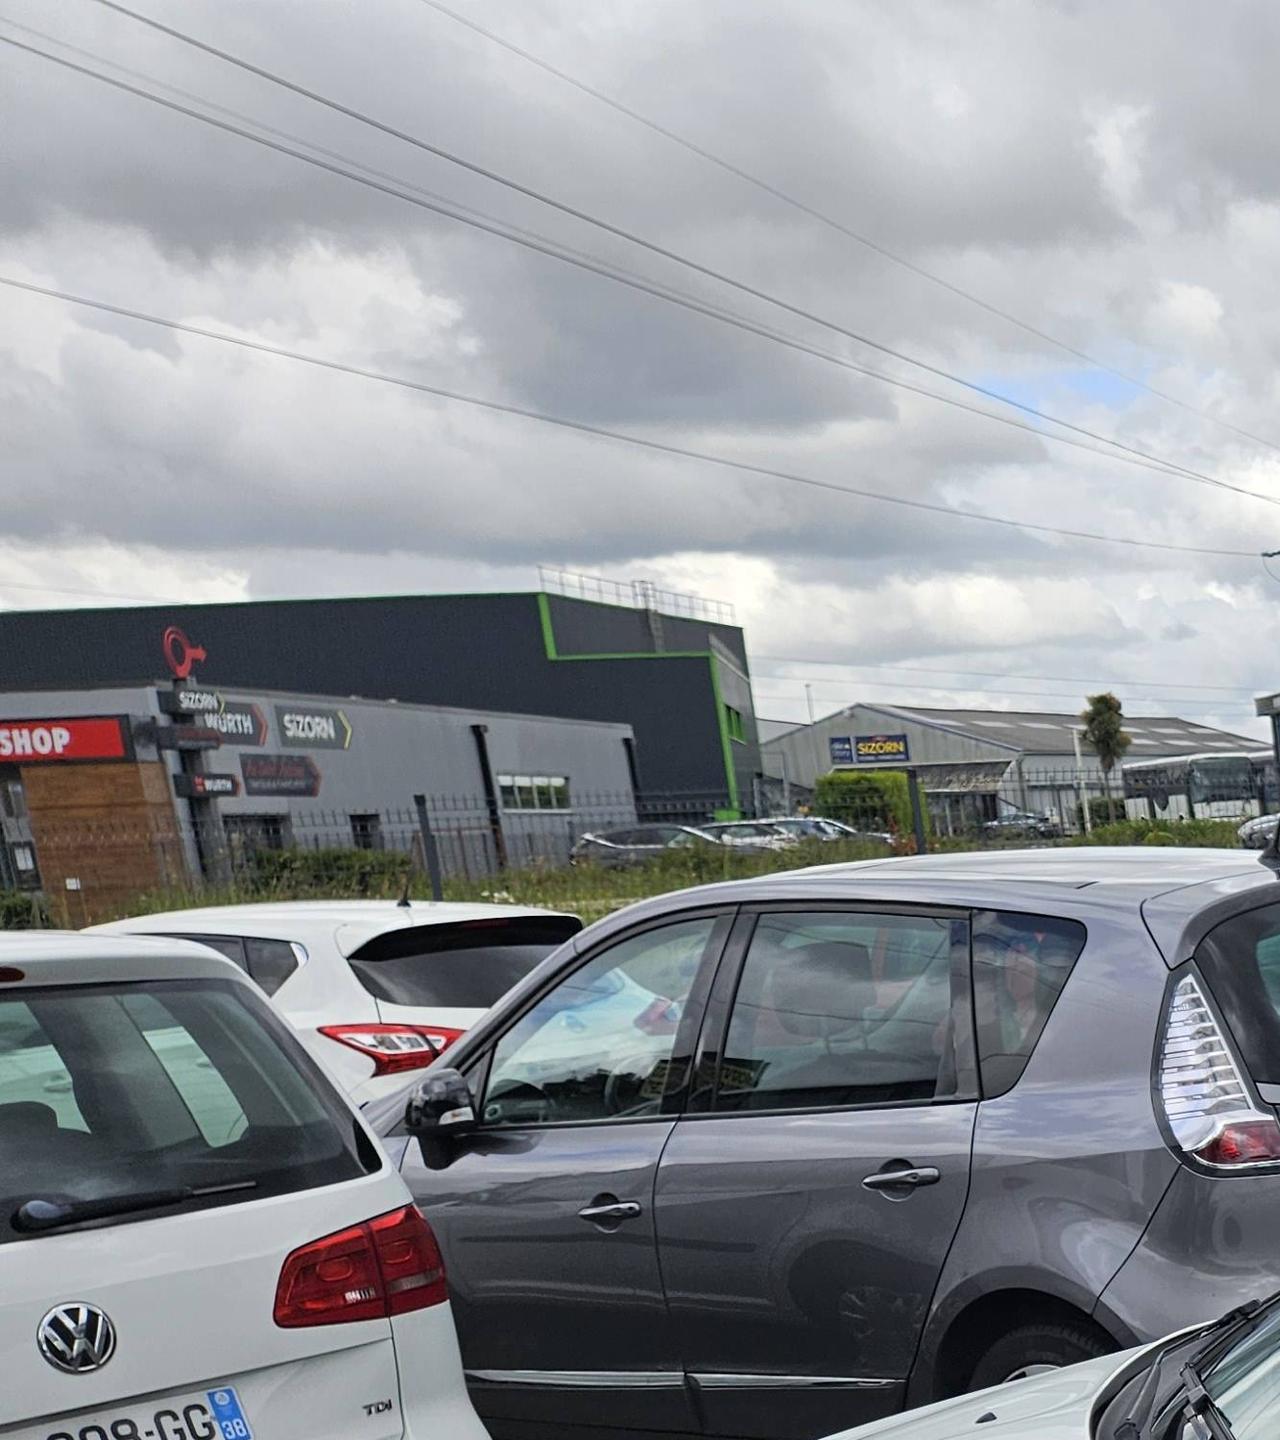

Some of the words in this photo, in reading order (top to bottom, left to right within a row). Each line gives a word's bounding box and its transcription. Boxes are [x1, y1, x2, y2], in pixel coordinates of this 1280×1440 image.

[283, 713, 336, 739] SIZORN
[857, 741, 904, 754] SIZORN
[222, 1418, 247, 1440] 38
